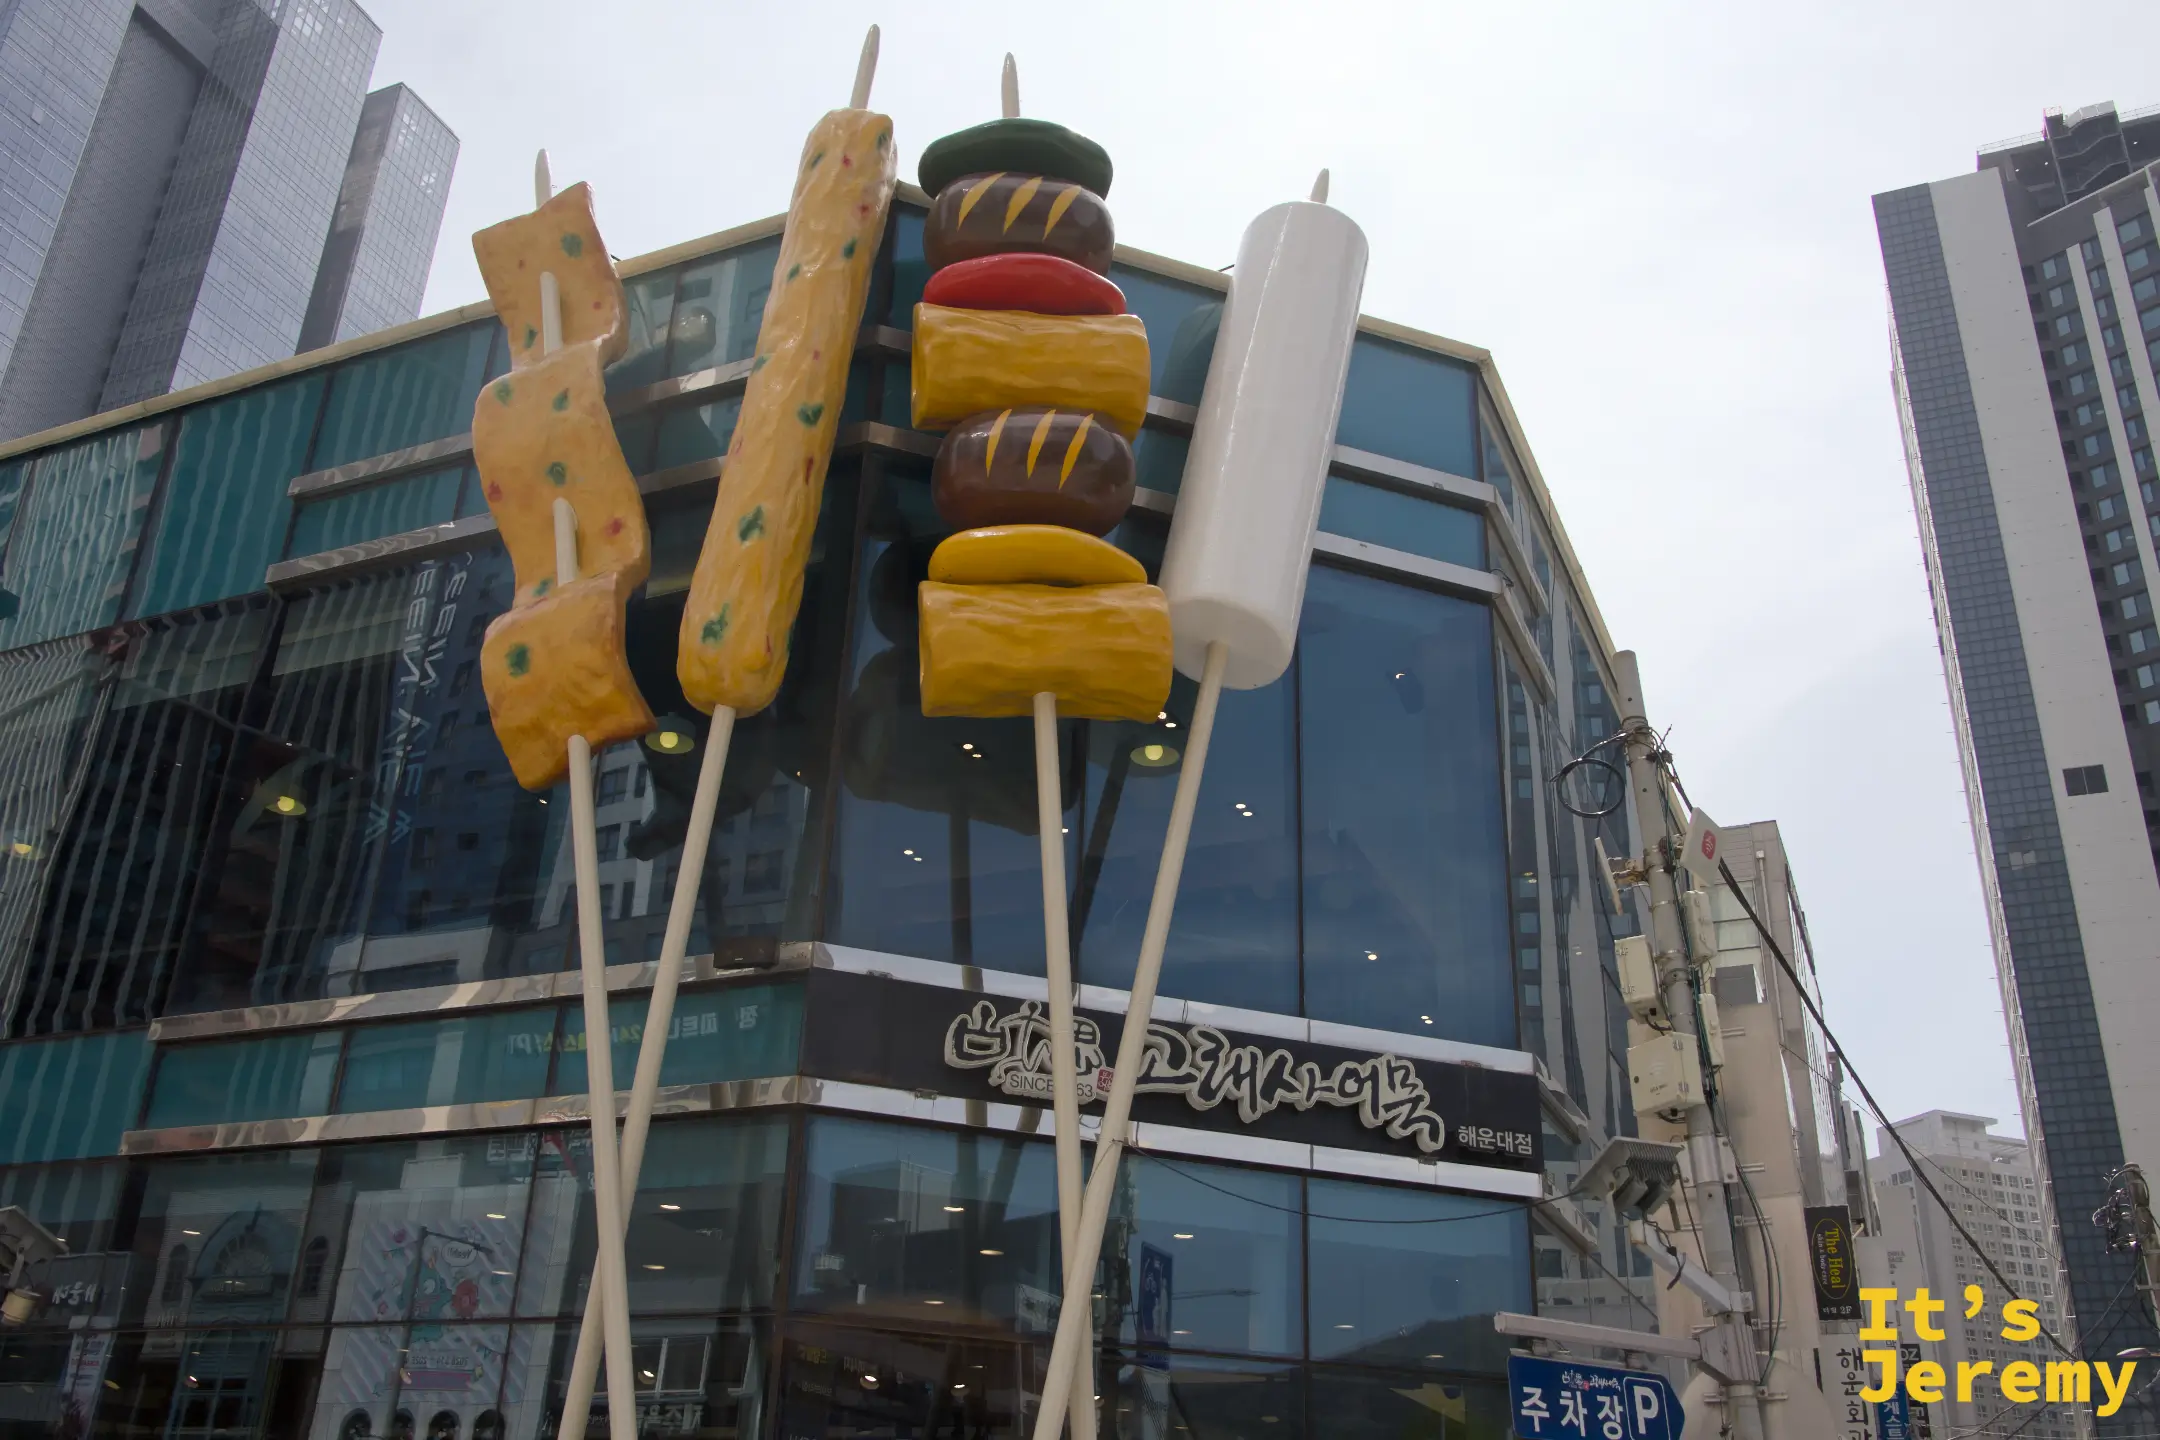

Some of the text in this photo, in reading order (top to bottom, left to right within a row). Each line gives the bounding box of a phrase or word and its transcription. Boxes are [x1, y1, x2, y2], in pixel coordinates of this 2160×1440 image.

[1009, 1074, 1054, 1093] SINCE
[1135, 1024, 1532, 1155] 고래사어묵 해운대점
[1825, 1227, 1847, 1289] The Heal
[1634, 1386, 1659, 1435] P
